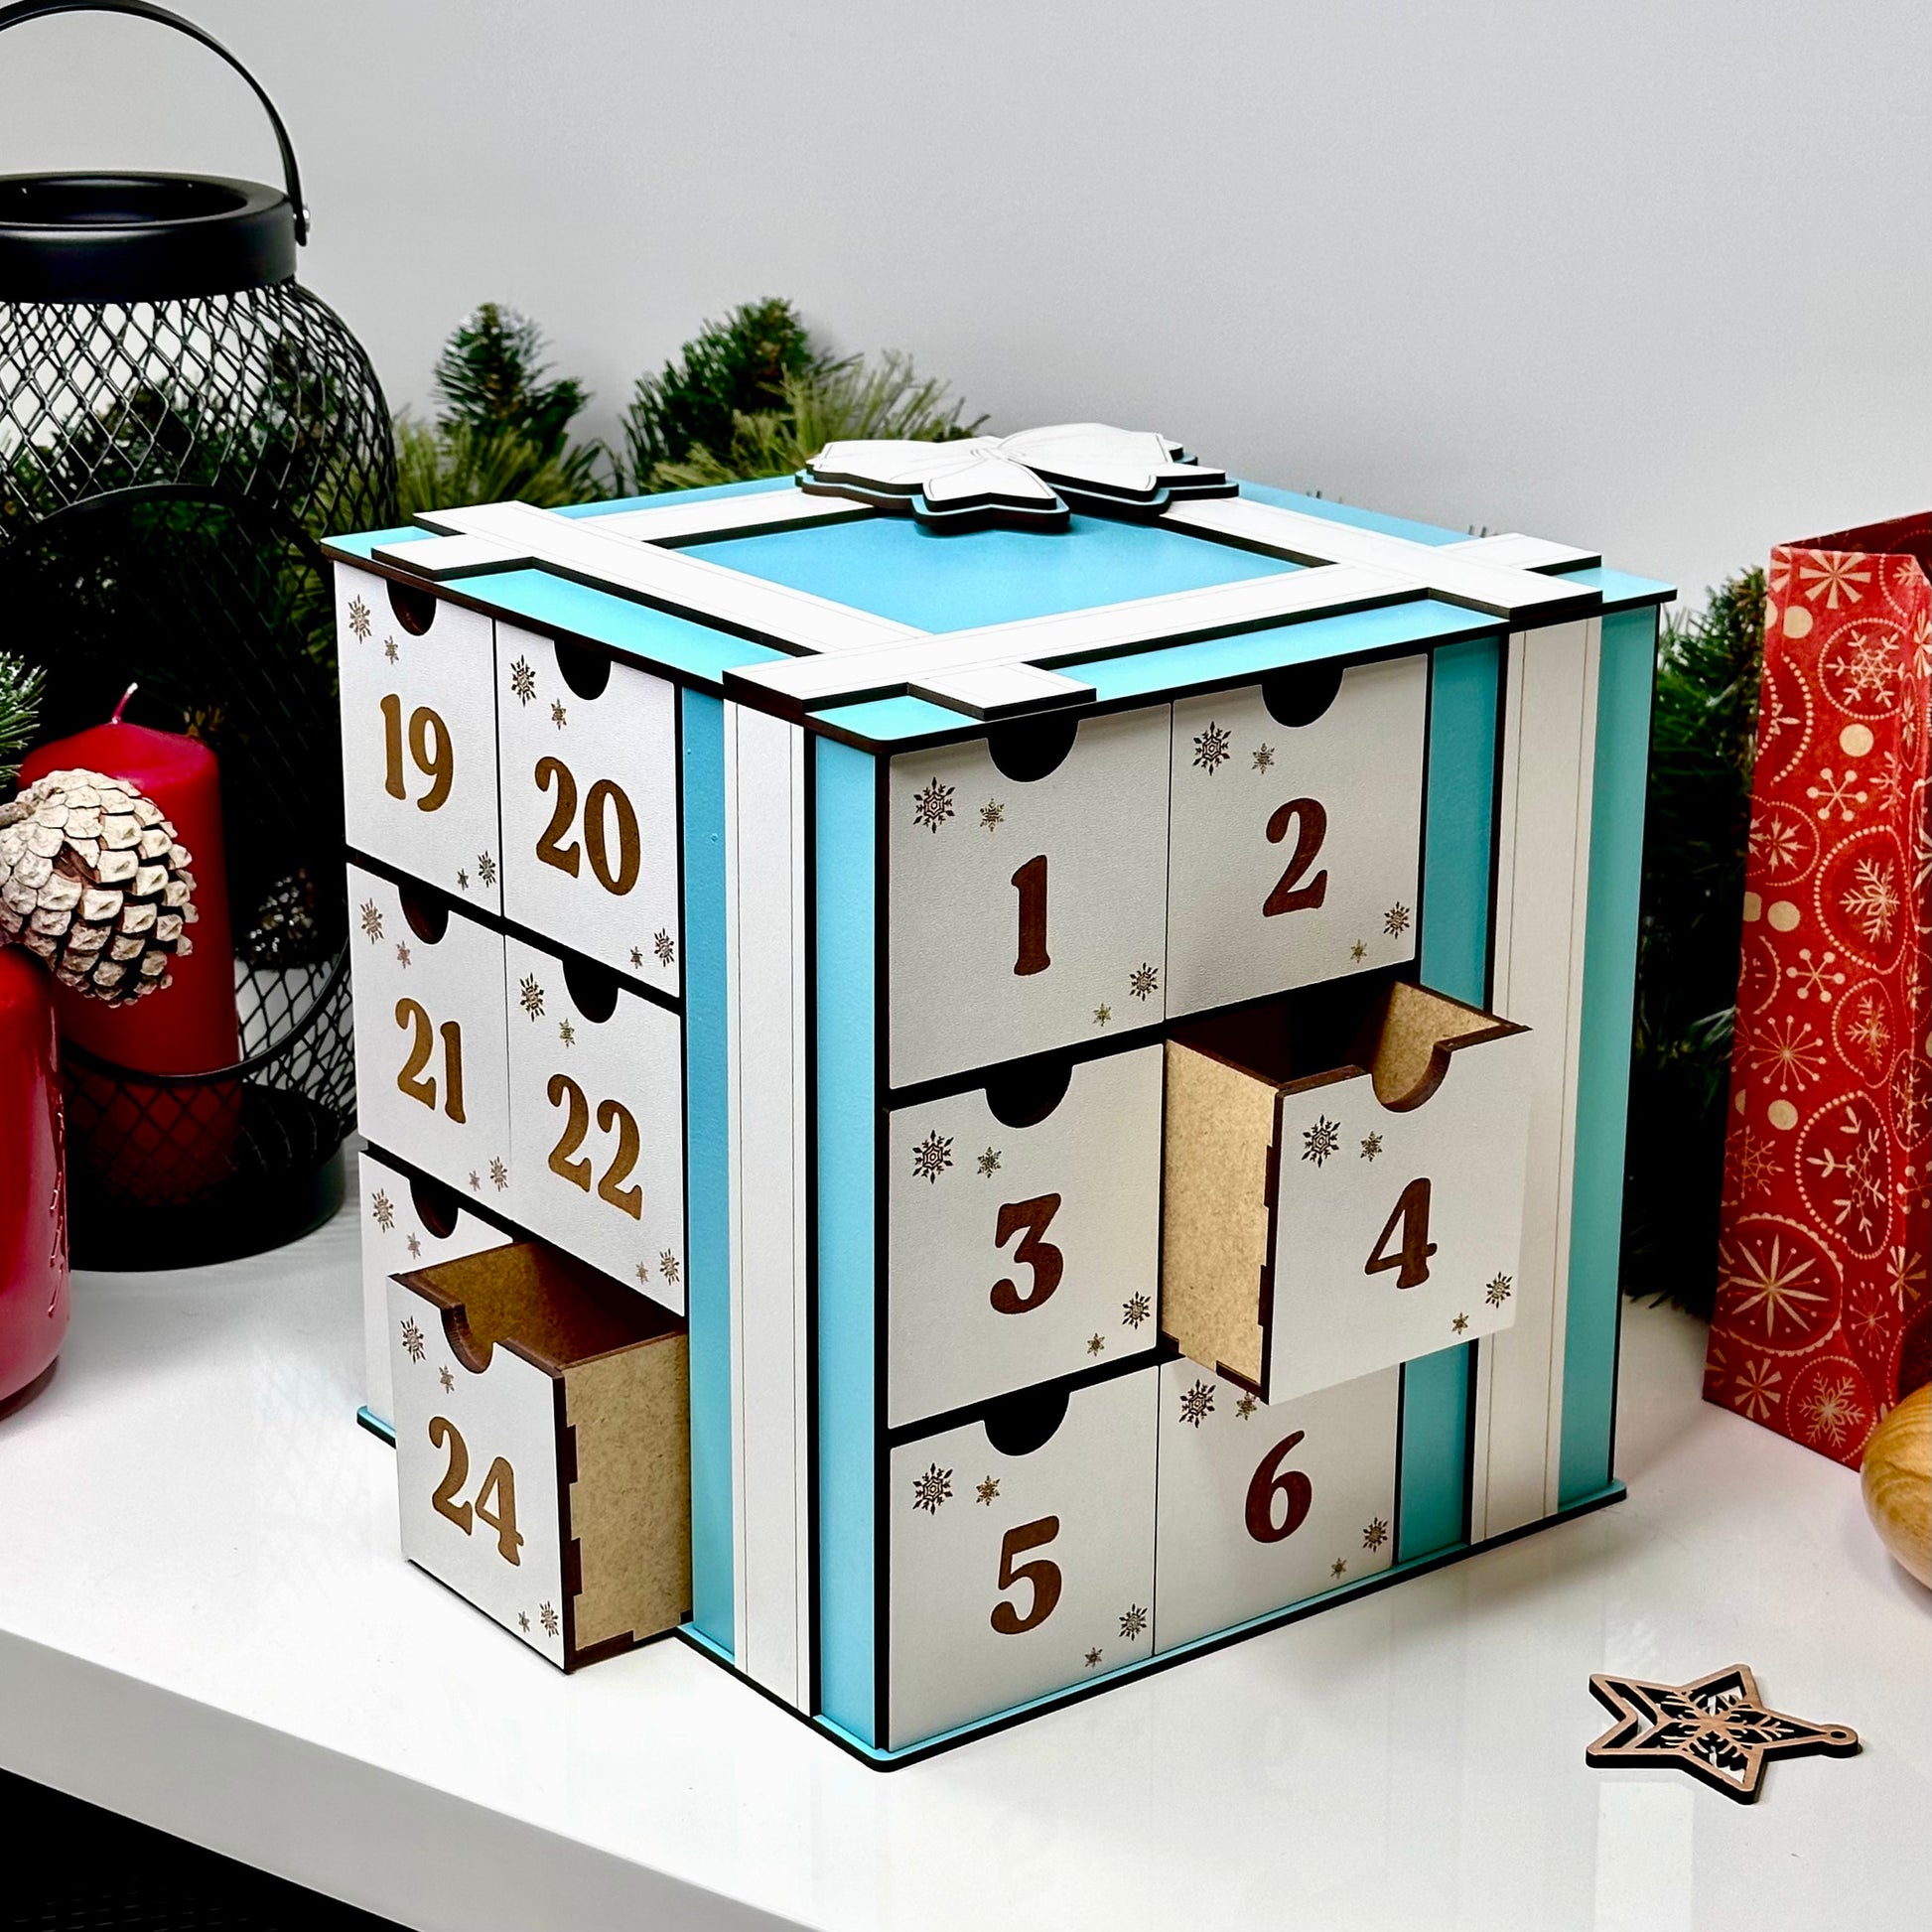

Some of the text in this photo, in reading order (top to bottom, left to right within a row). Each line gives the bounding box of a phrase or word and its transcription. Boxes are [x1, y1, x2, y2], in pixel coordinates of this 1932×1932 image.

[380, 694, 454, 812] 19
[534, 757, 640, 896] 20
[1263, 798, 1327, 917] 2
[1011, 855, 1050, 976] 1
[395, 998, 466, 1124] 21
[547, 1074, 642, 1220] 22
[990, 1193, 1063, 1314] 3
[1364, 1177, 1438, 1290] 4
[429, 1417, 524, 1567] 24
[1245, 1431, 1311, 1543] 6
[991, 1516, 1061, 1635] 5
